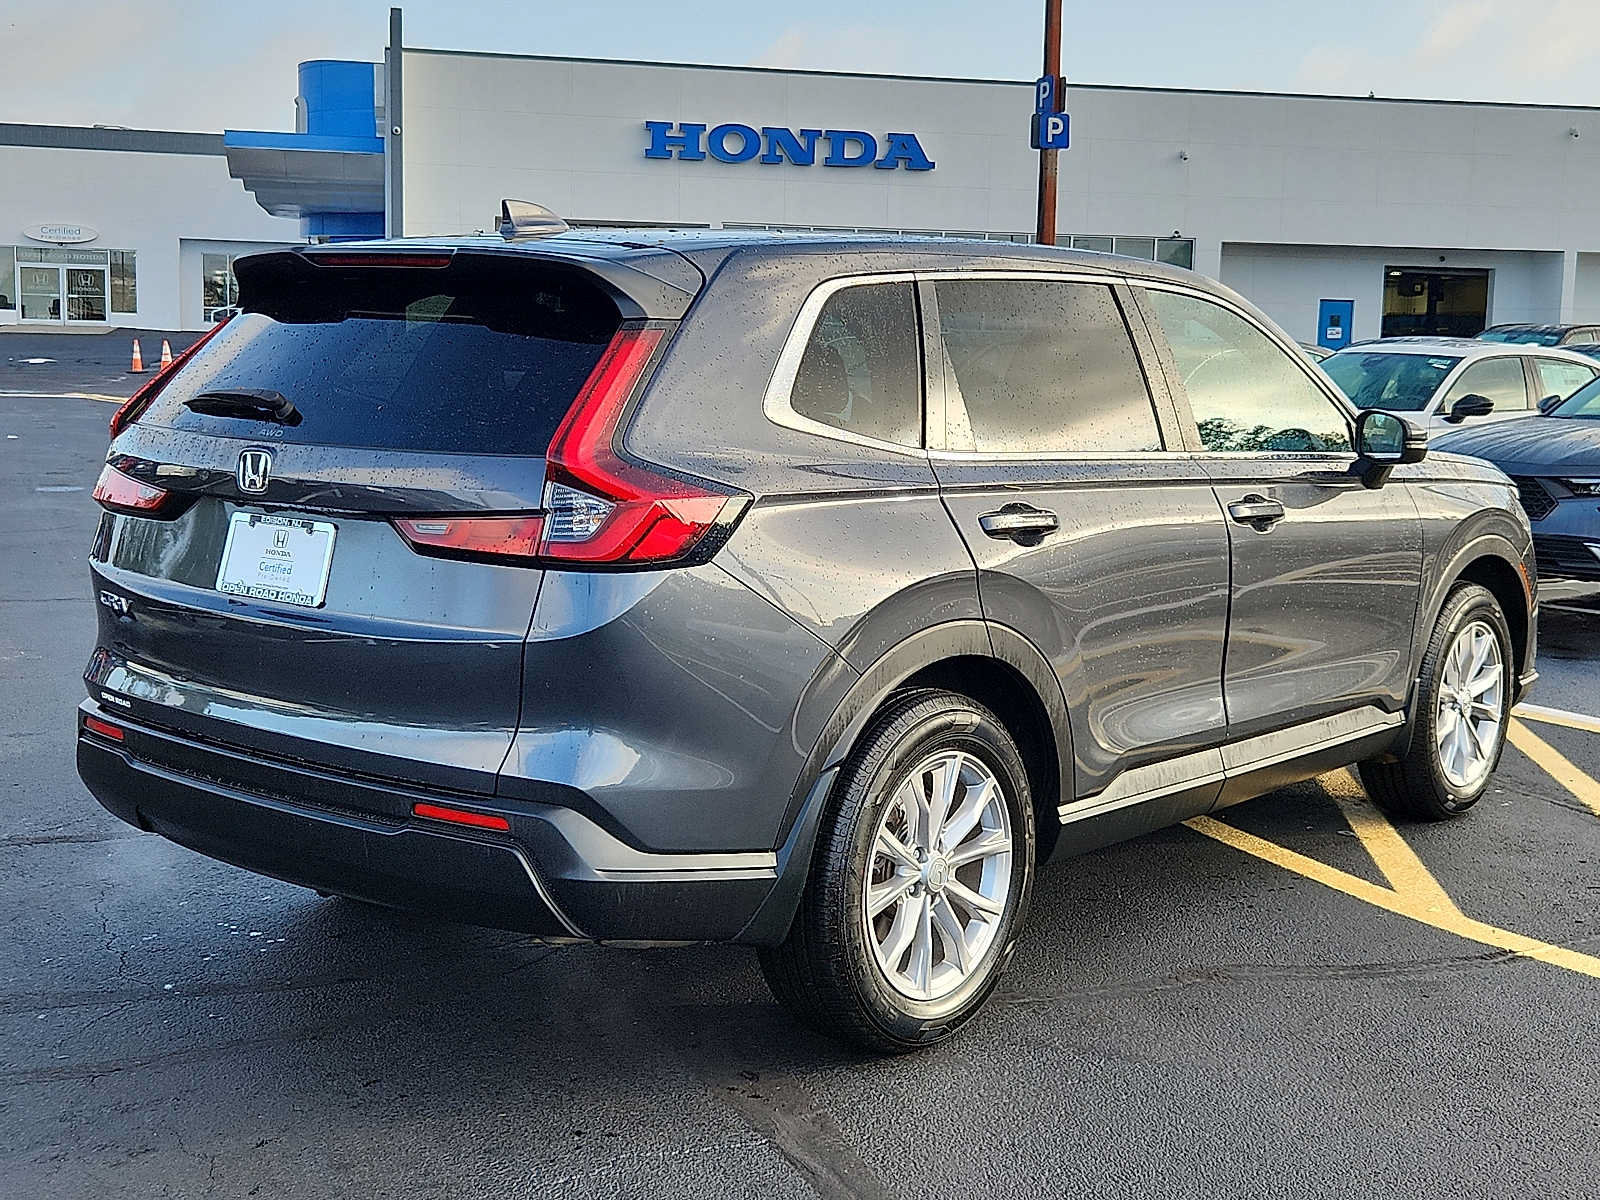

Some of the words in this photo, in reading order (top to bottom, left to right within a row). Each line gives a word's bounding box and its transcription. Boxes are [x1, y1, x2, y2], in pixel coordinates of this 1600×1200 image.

[1039, 82, 1050, 108] P
[1047, 117, 1064, 143] P
[644, 120, 936, 171] HONDA
[259, 428, 284, 437] AWD
[265, 548, 292, 557] HONDA
[259, 561, 293, 575] Certified
[221, 582, 248, 595] OPEN
[248, 587, 277, 600] ROAD
[278, 590, 314, 605] HONDA
